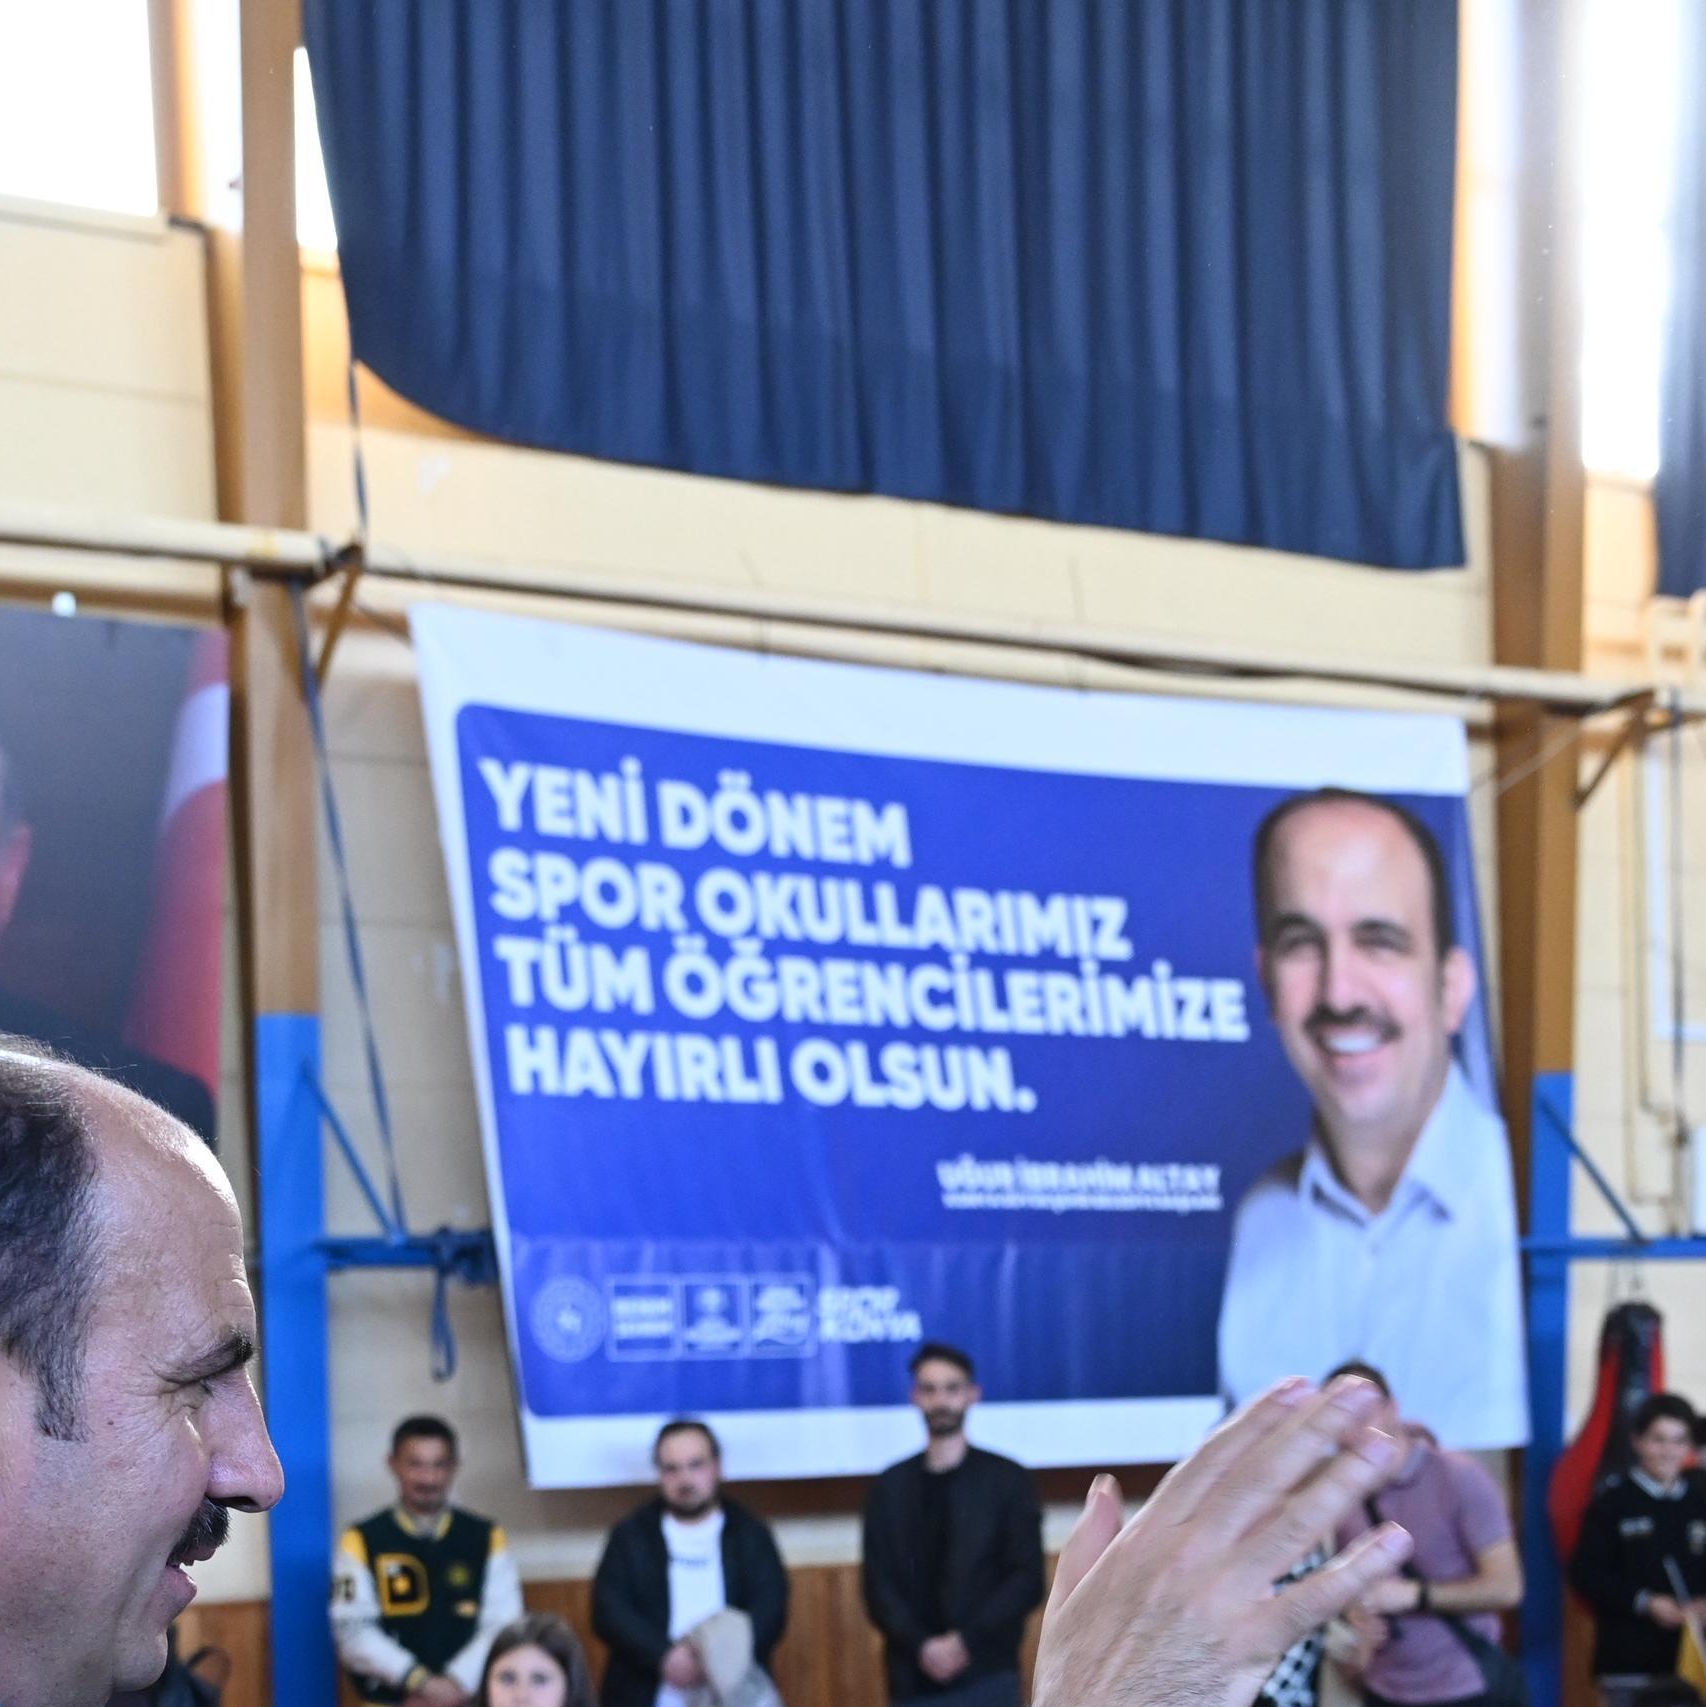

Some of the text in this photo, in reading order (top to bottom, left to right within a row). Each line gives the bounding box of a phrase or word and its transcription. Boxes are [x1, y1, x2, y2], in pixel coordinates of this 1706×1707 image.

[477, 756, 911, 867] YENİ DÖNEM
[489, 847, 1133, 962] SPOR OKULLARIMIZ
[493, 923, 1250, 1043] TÜM ÖĞRENCİLERİMİZE
[505, 1025, 1037, 1113] HAYIRLI OLSUN.
